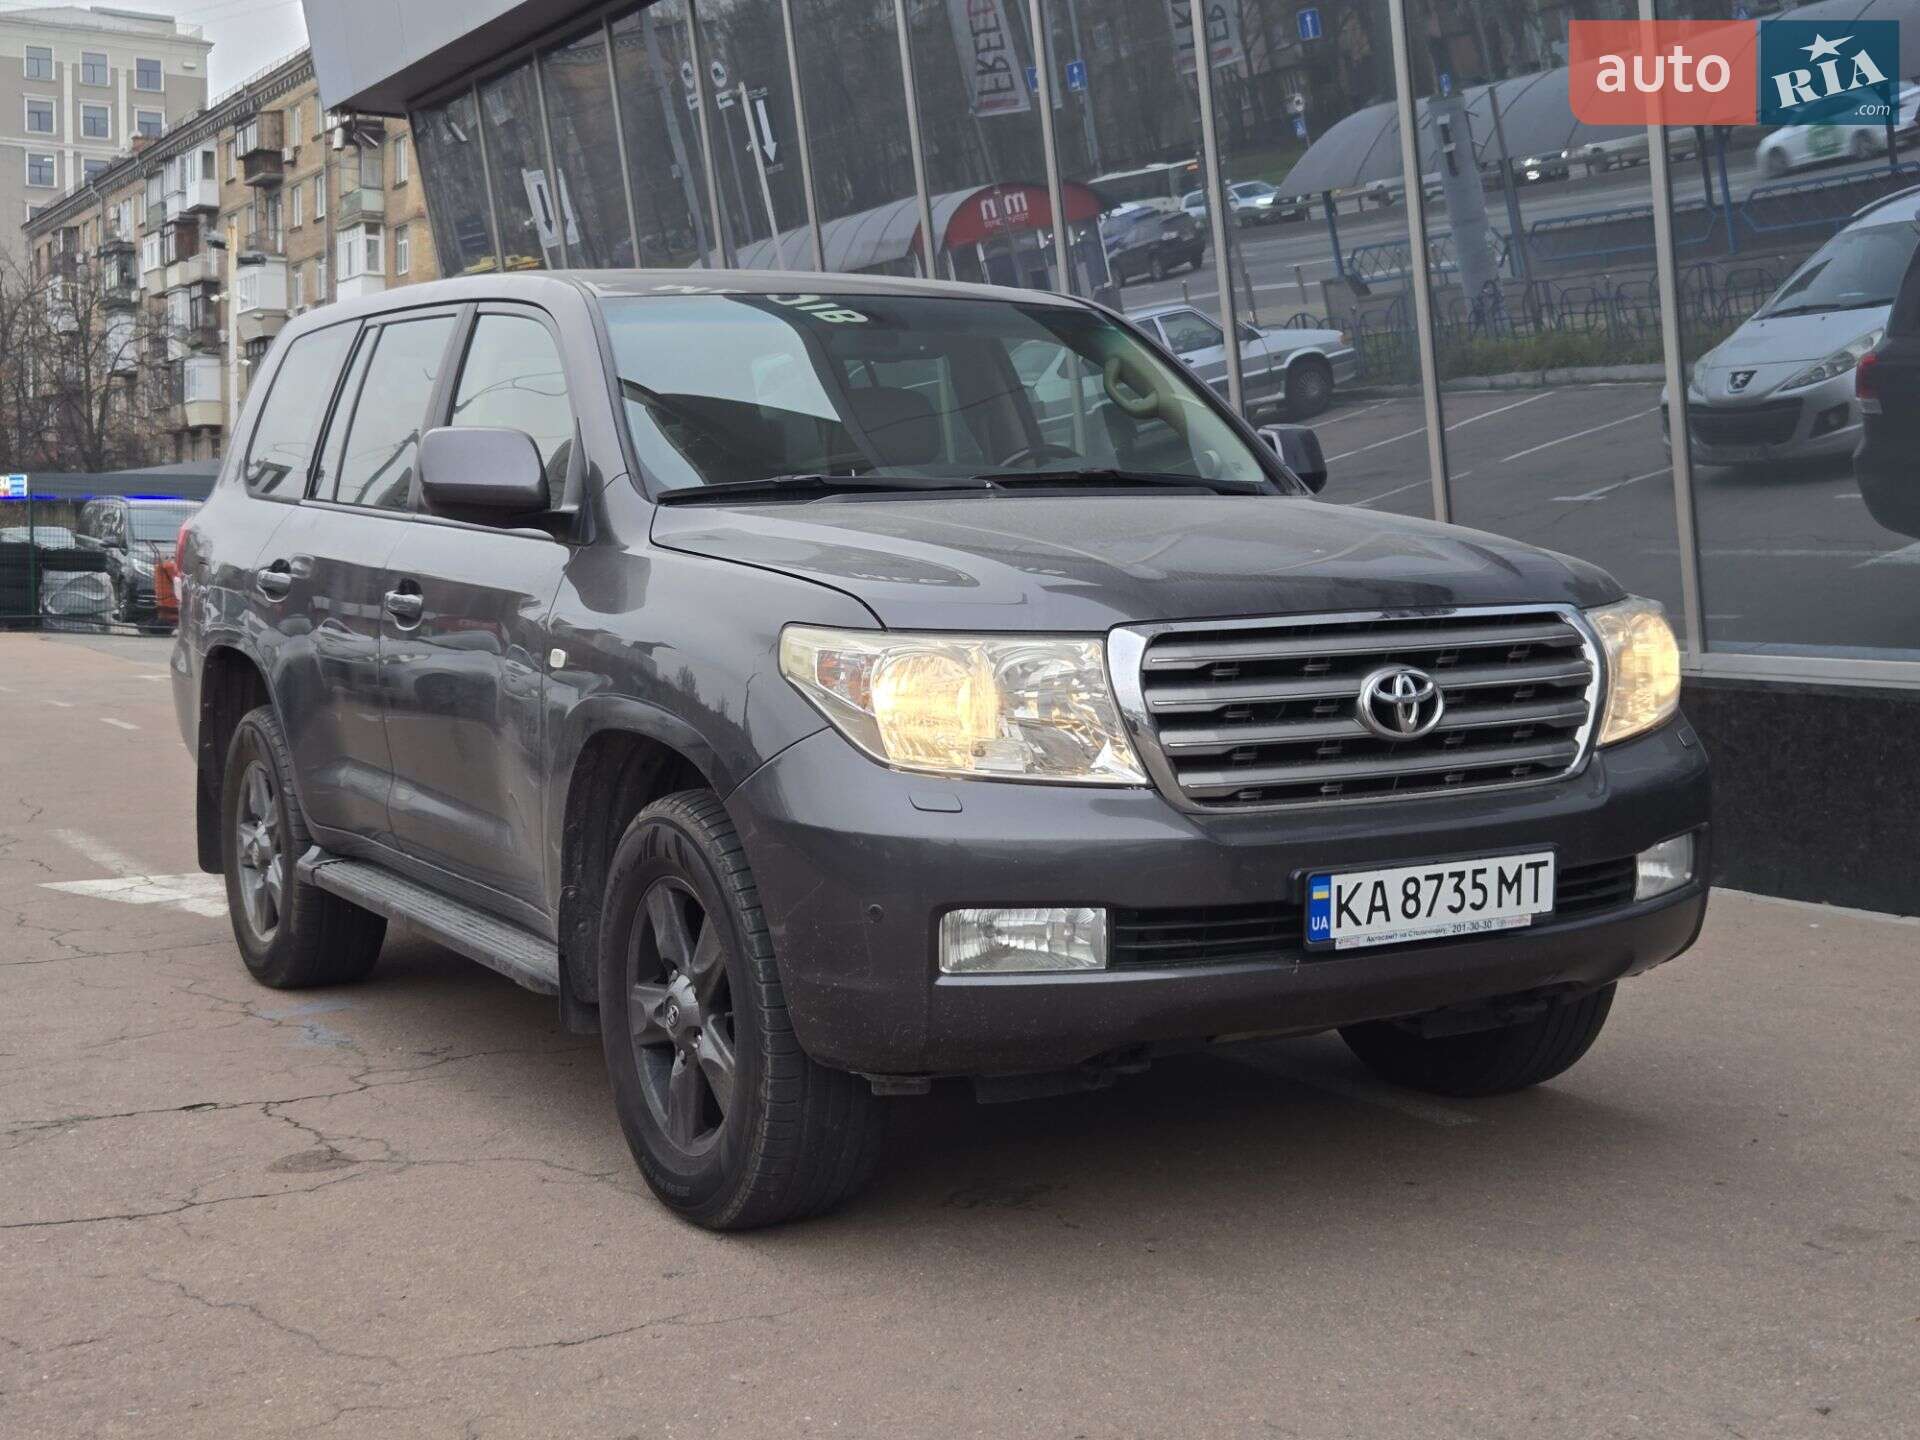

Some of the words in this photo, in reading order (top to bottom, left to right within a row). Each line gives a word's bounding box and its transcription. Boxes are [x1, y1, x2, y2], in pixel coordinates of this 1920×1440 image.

[1335, 880, 1391, 929] KA
[1401, 868, 1488, 920] 8735
[1497, 860, 1549, 908] MT
[1311, 915, 1329, 931] UA
